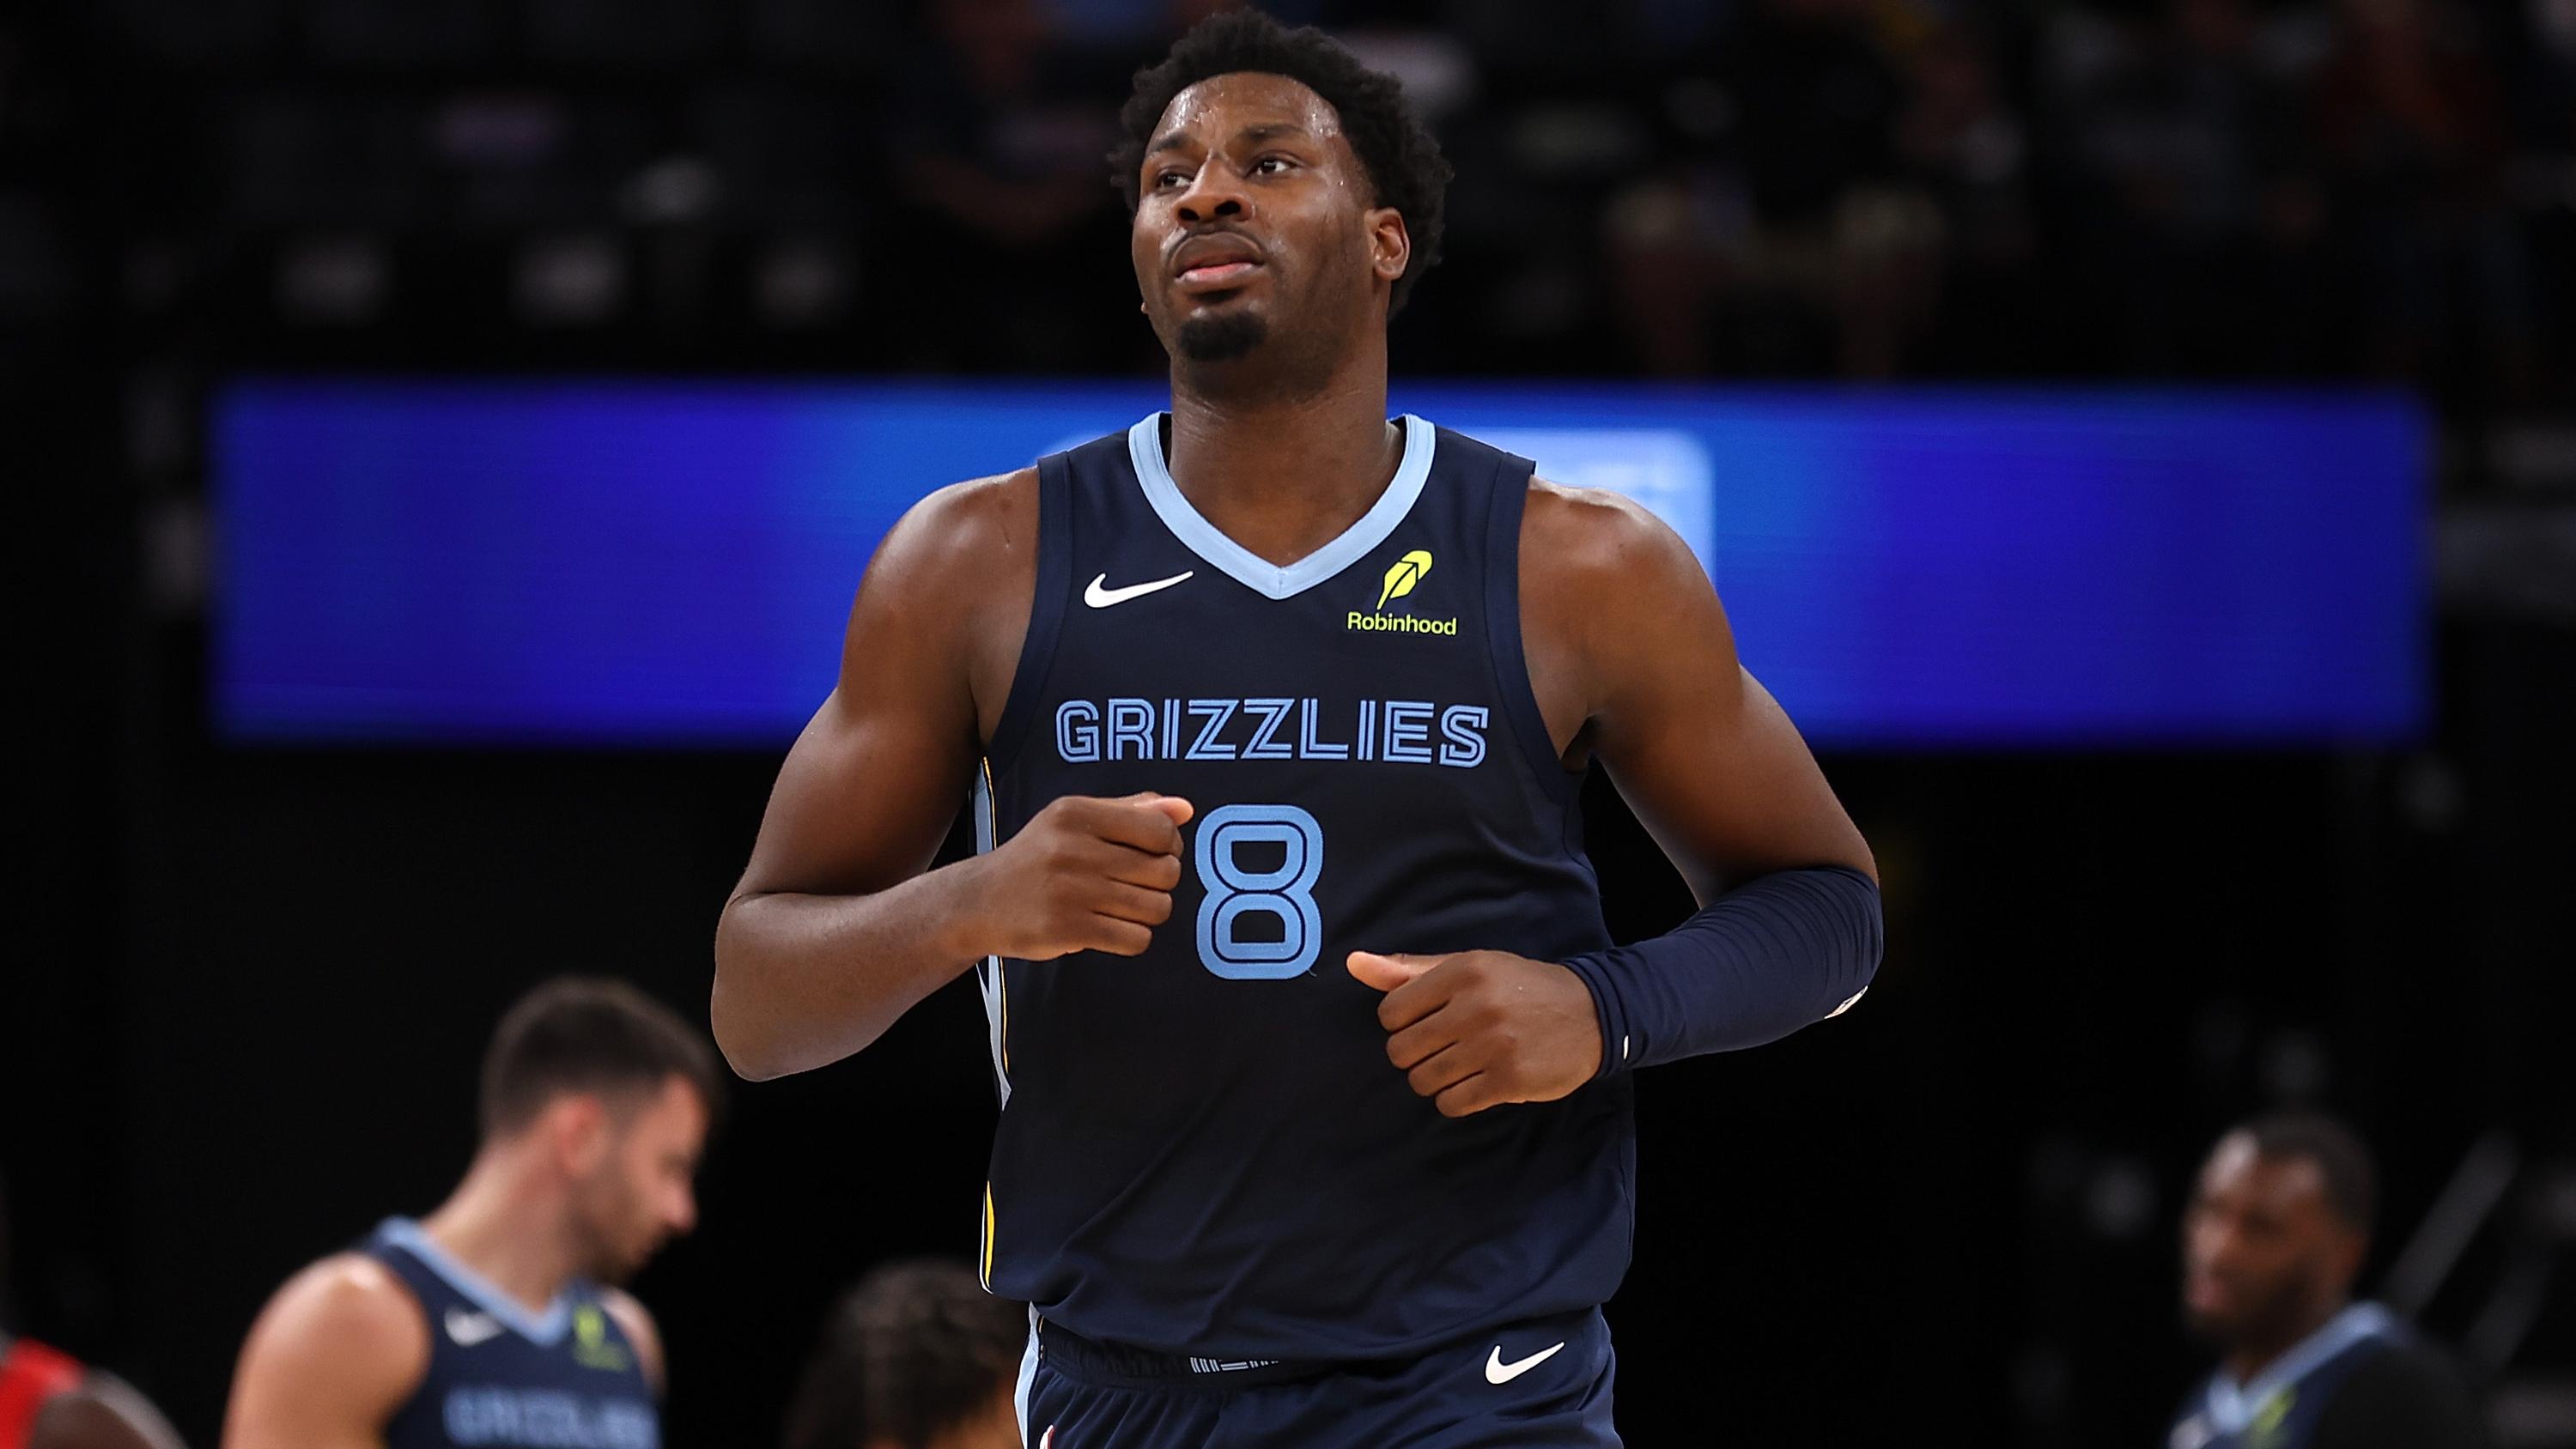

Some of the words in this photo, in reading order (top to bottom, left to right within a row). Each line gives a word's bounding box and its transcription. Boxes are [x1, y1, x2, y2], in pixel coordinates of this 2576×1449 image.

[1347, 611, 1457, 636] Robinhood
[1055, 698, 1489, 768] GRIZZLIES
[1194, 804, 1323, 980] 8
